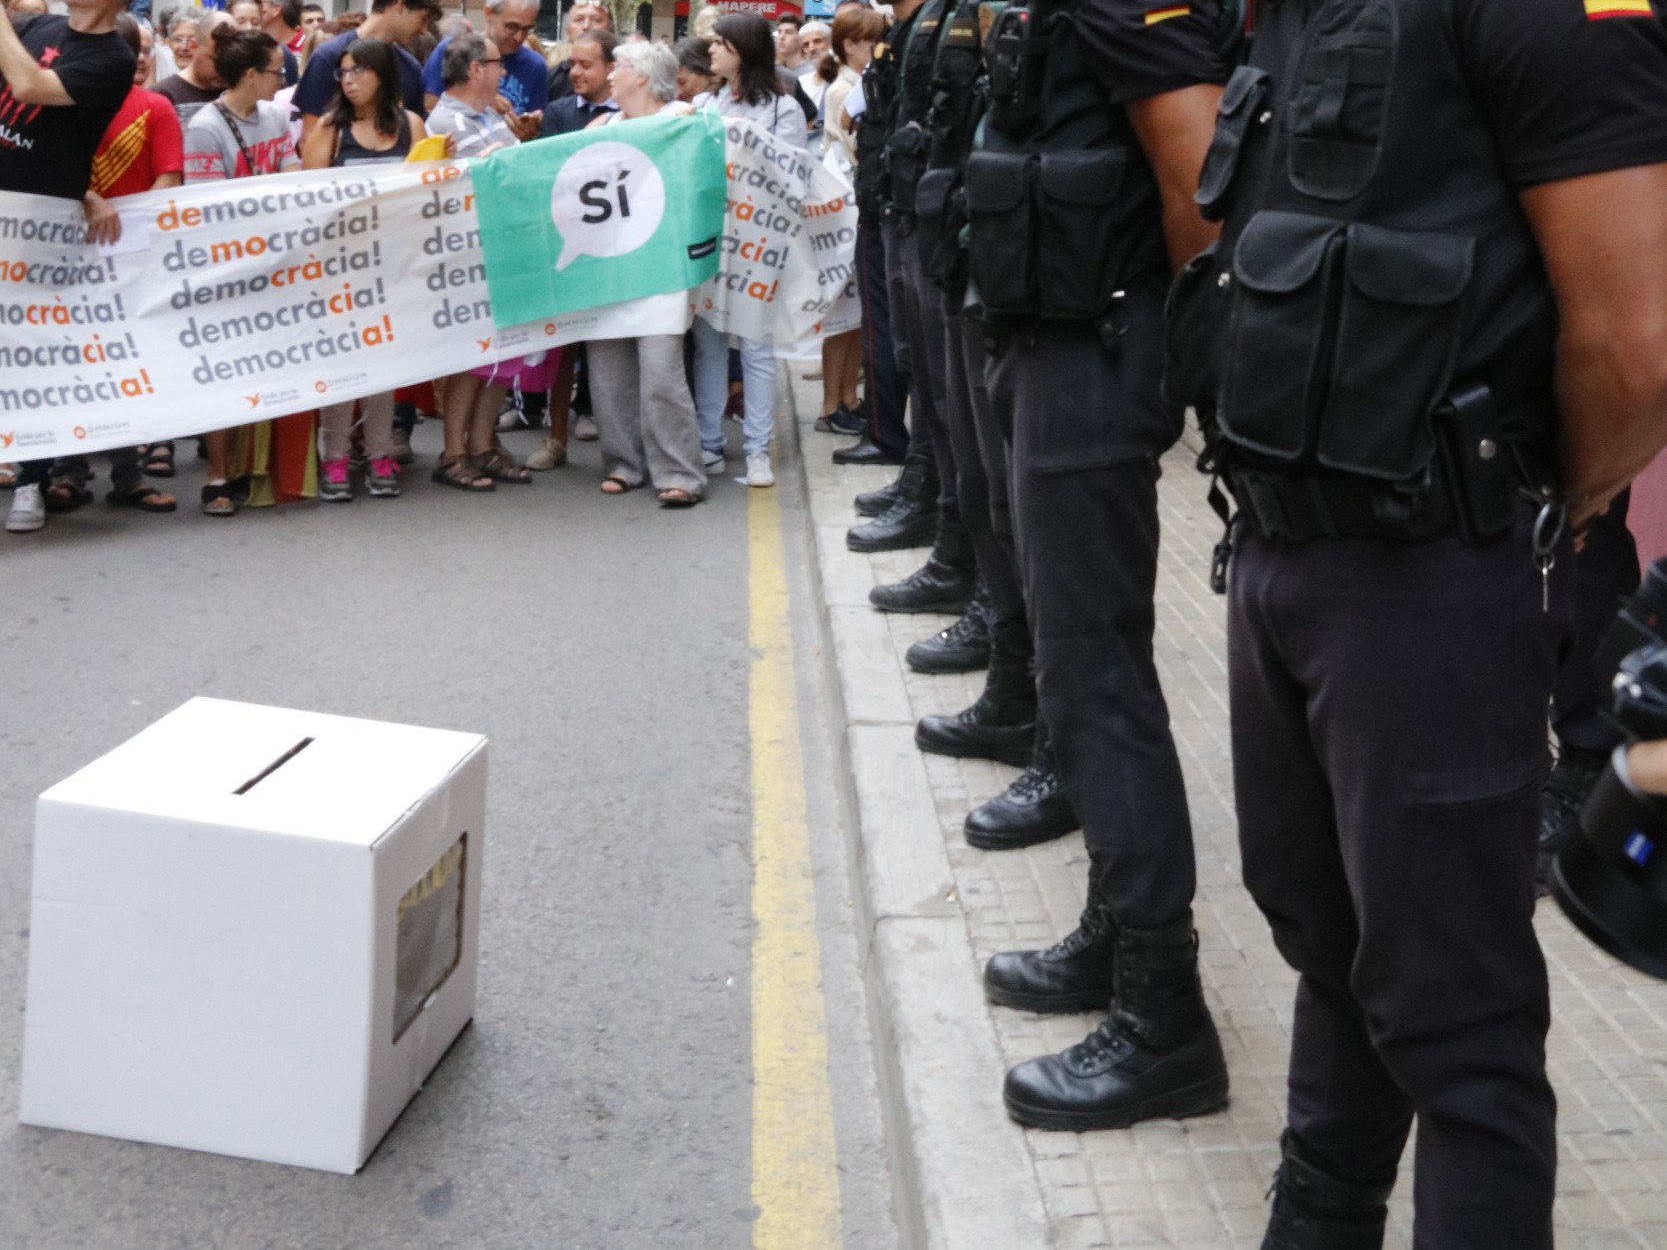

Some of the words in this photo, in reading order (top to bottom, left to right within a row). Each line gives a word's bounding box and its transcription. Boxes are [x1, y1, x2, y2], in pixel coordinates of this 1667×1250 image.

[156, 181, 380, 232] democràcia!
[579, 169, 630, 224] Sí
[163, 205, 379, 273] democràcia!
[170, 241, 382, 310] democràcia!
[179, 278, 387, 349] democràcia!
[192, 315, 394, 385] democràcia!
